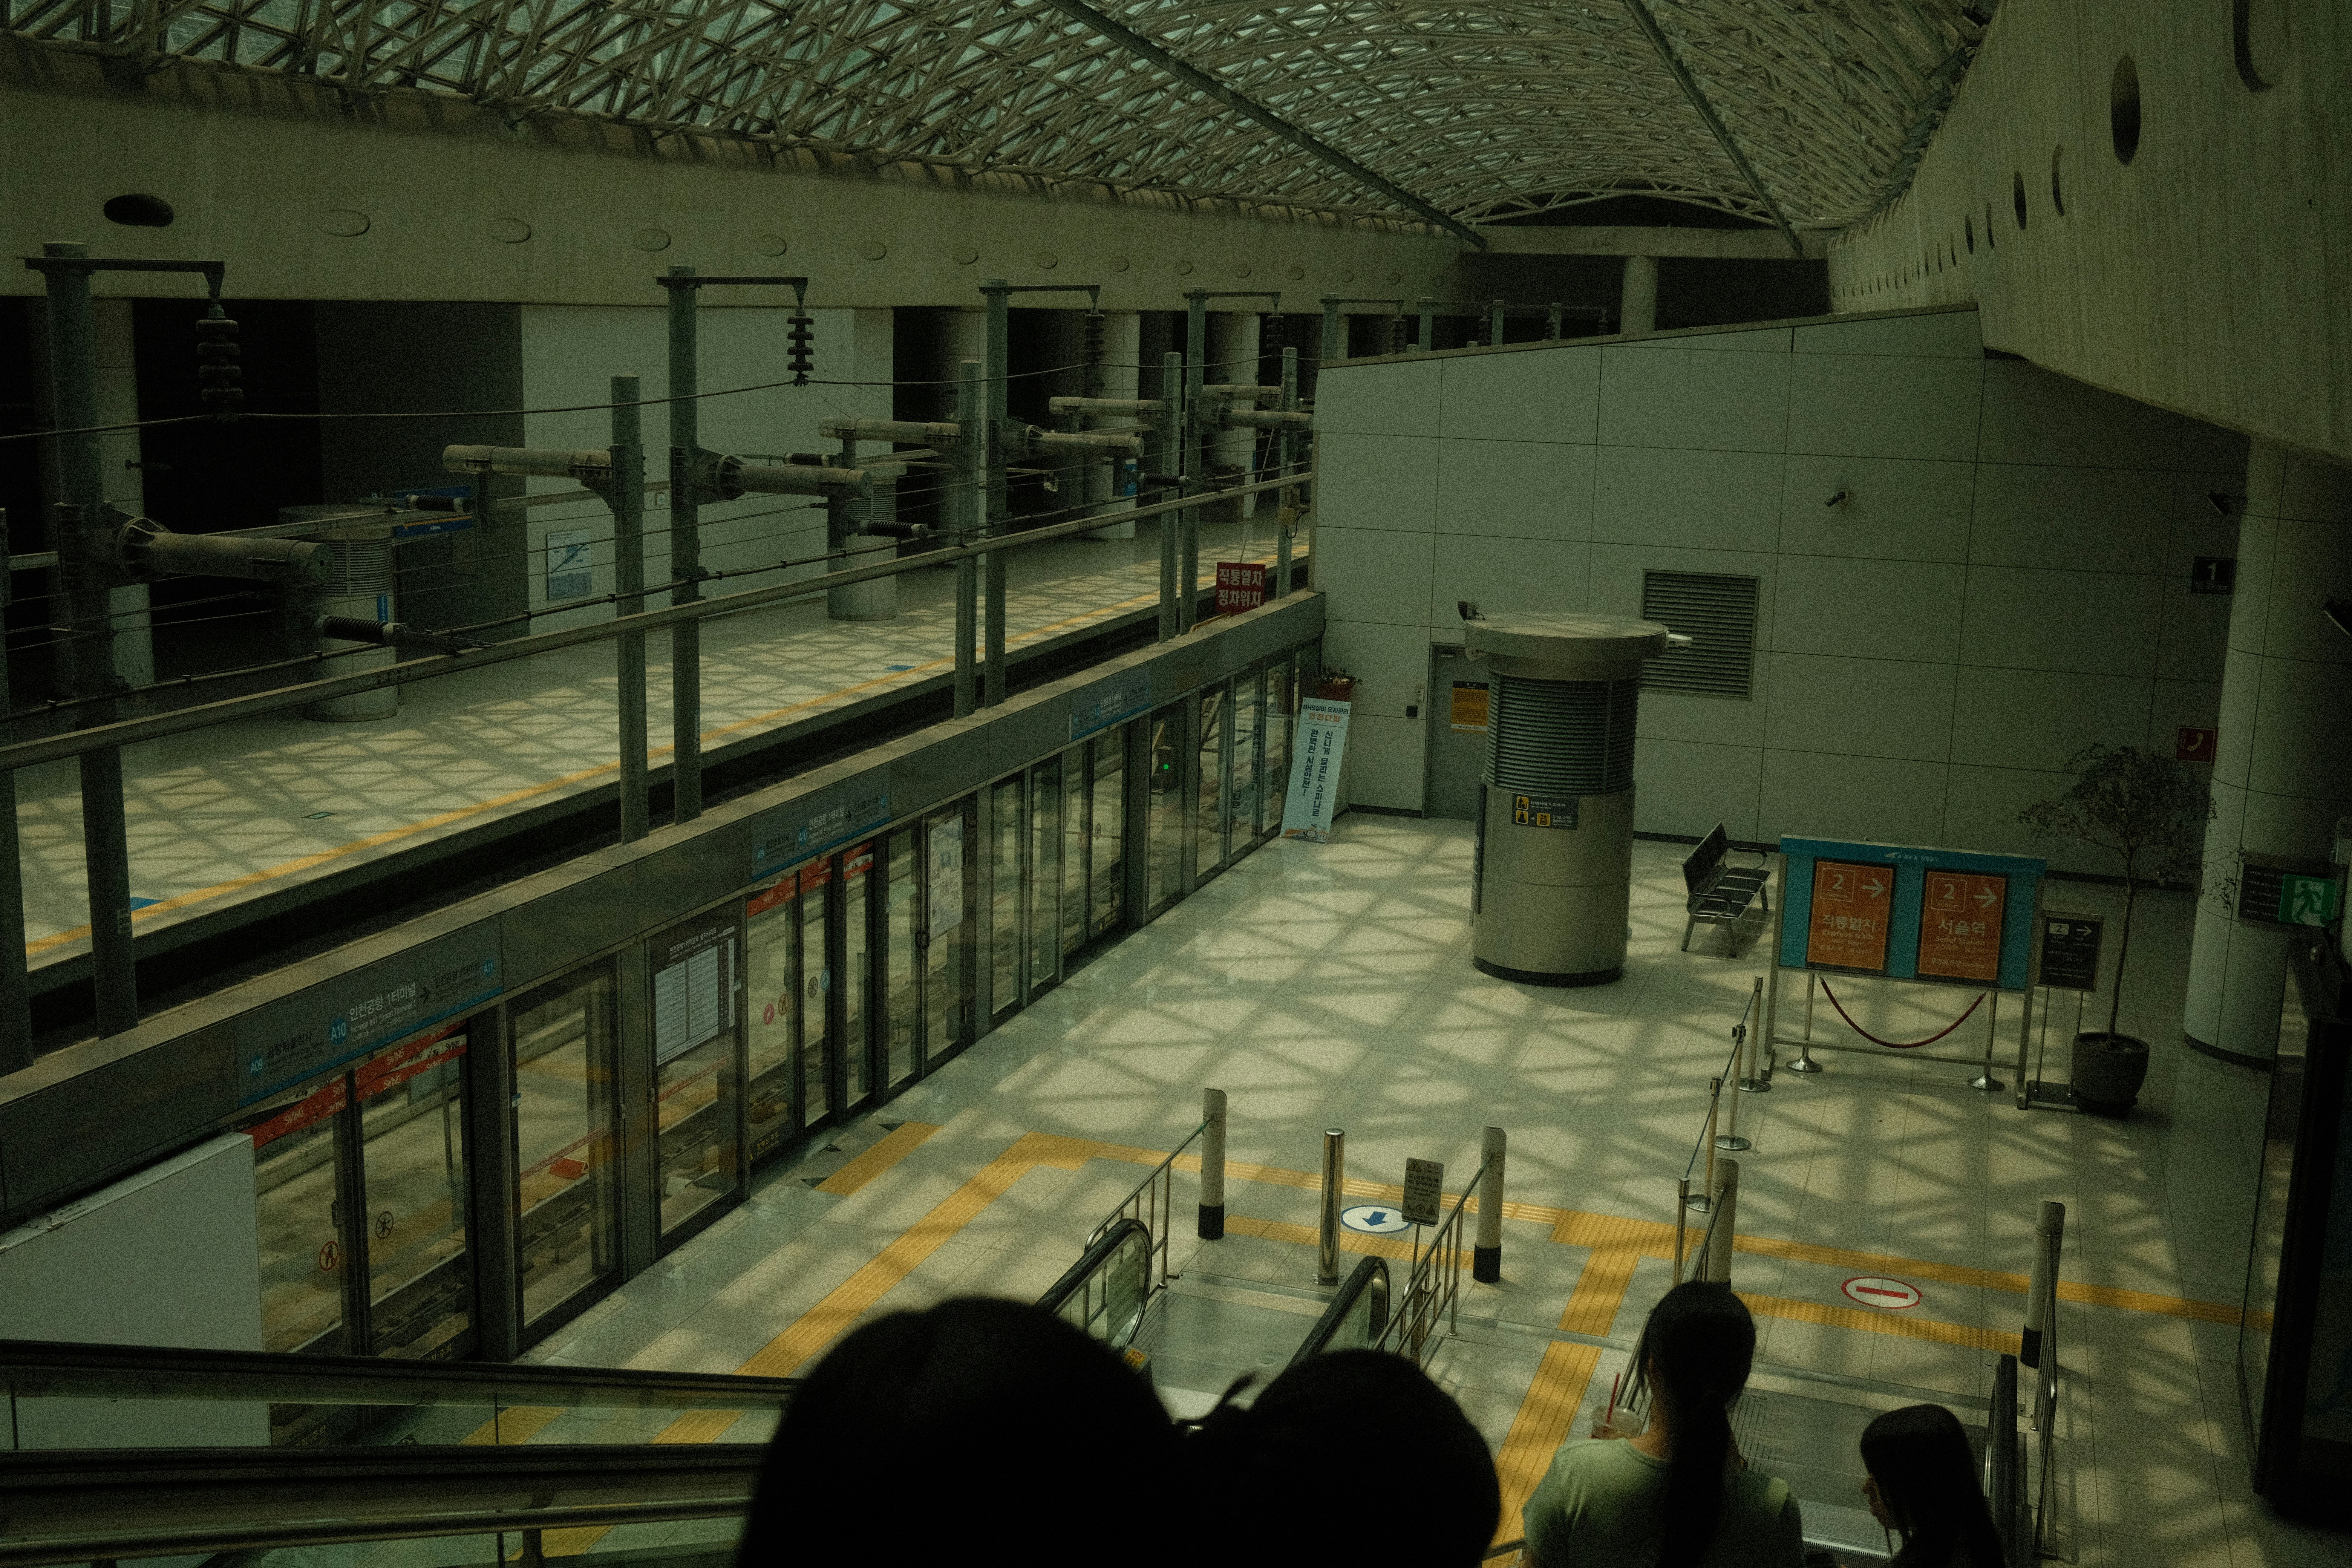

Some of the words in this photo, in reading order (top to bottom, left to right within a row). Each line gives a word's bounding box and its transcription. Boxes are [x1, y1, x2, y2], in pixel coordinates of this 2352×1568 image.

[1219, 568, 1262, 586] 직통열차
[2208, 562, 2216, 580] 1
[1218, 590, 1261, 607] 정차위치
[1308, 729, 1318, 753] 완벽한
[1323, 731, 1333, 755] 신나게
[1302, 756, 1314, 796] 시설안전!
[1318, 758, 1328, 782] 달리는
[1832, 874, 1844, 890] 2
[1943, 884, 1955, 900] 2
[1822, 914, 1875, 932] 직통열차
[1938, 919, 1986, 937] 서울역
[1822, 928, 1852, 938] Express
[1959, 938, 1985, 946] Station
[349, 995, 383, 1021] 인천공항
[387, 981, 416, 1005] 1터미널
[331, 1022, 346, 1041] A10
[251, 1059, 263, 1074] A09
[285, 1106, 304, 1127] SWING
[440, 1344, 452, 1358] 주의
[312, 1425, 326, 1440] 주의
